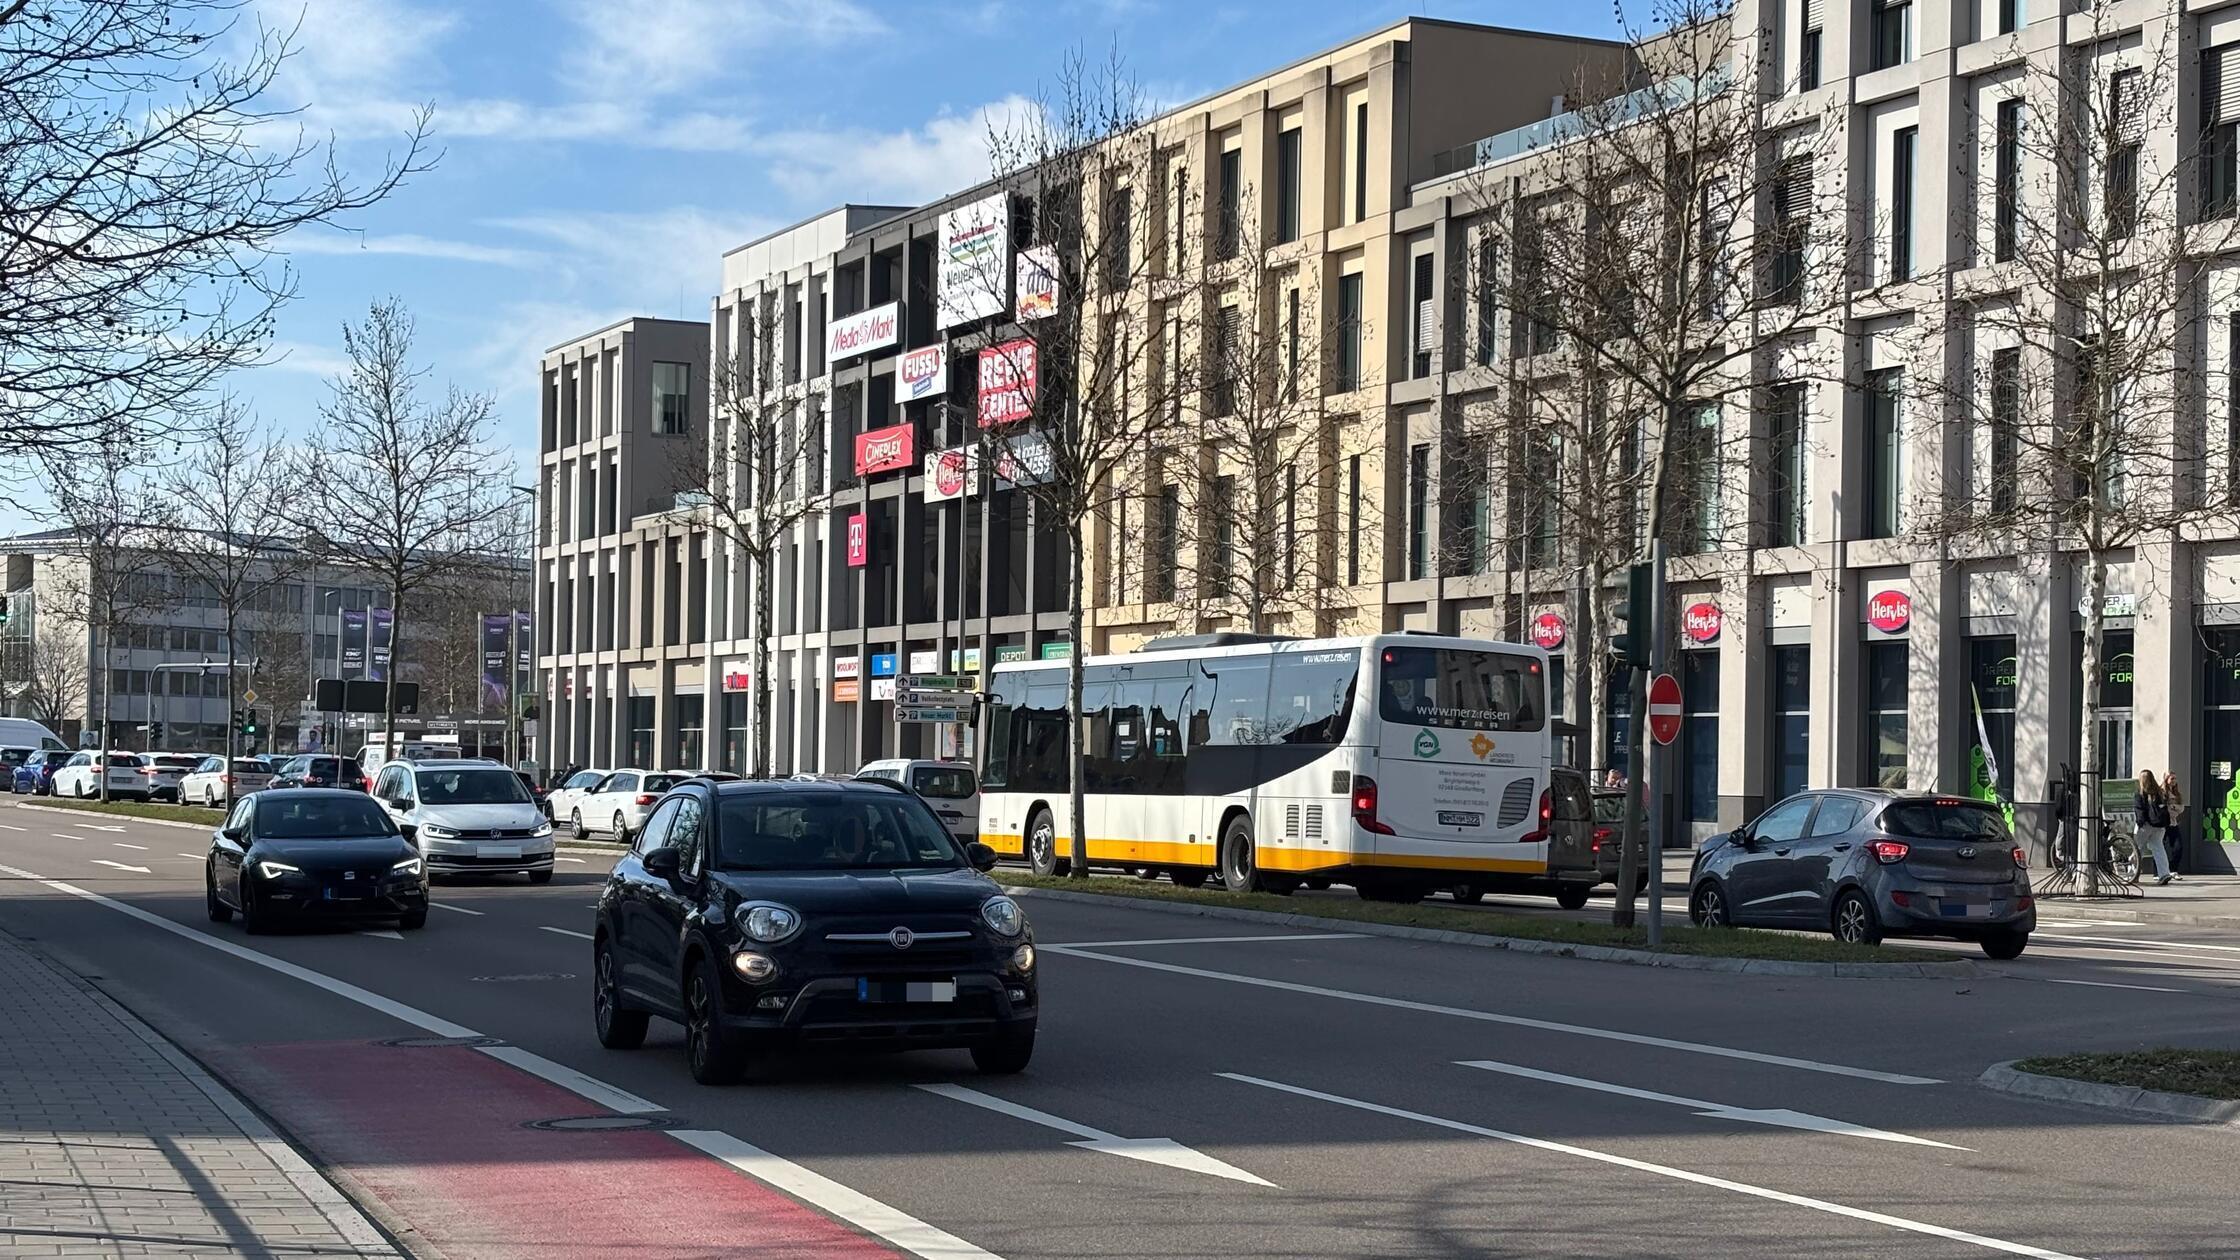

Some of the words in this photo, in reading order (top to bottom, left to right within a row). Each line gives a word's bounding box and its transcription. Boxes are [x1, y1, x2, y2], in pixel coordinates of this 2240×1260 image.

[905, 351, 938, 379] FUSSL
[980, 345, 1034, 390] REWE
[865, 438, 902, 464] CINEPLEX
[1871, 600, 1908, 622] Hervis
[1534, 622, 1562, 640] Hervis
[1687, 613, 1718, 632] Hervis
[1000, 651, 1026, 662] DEPOT
